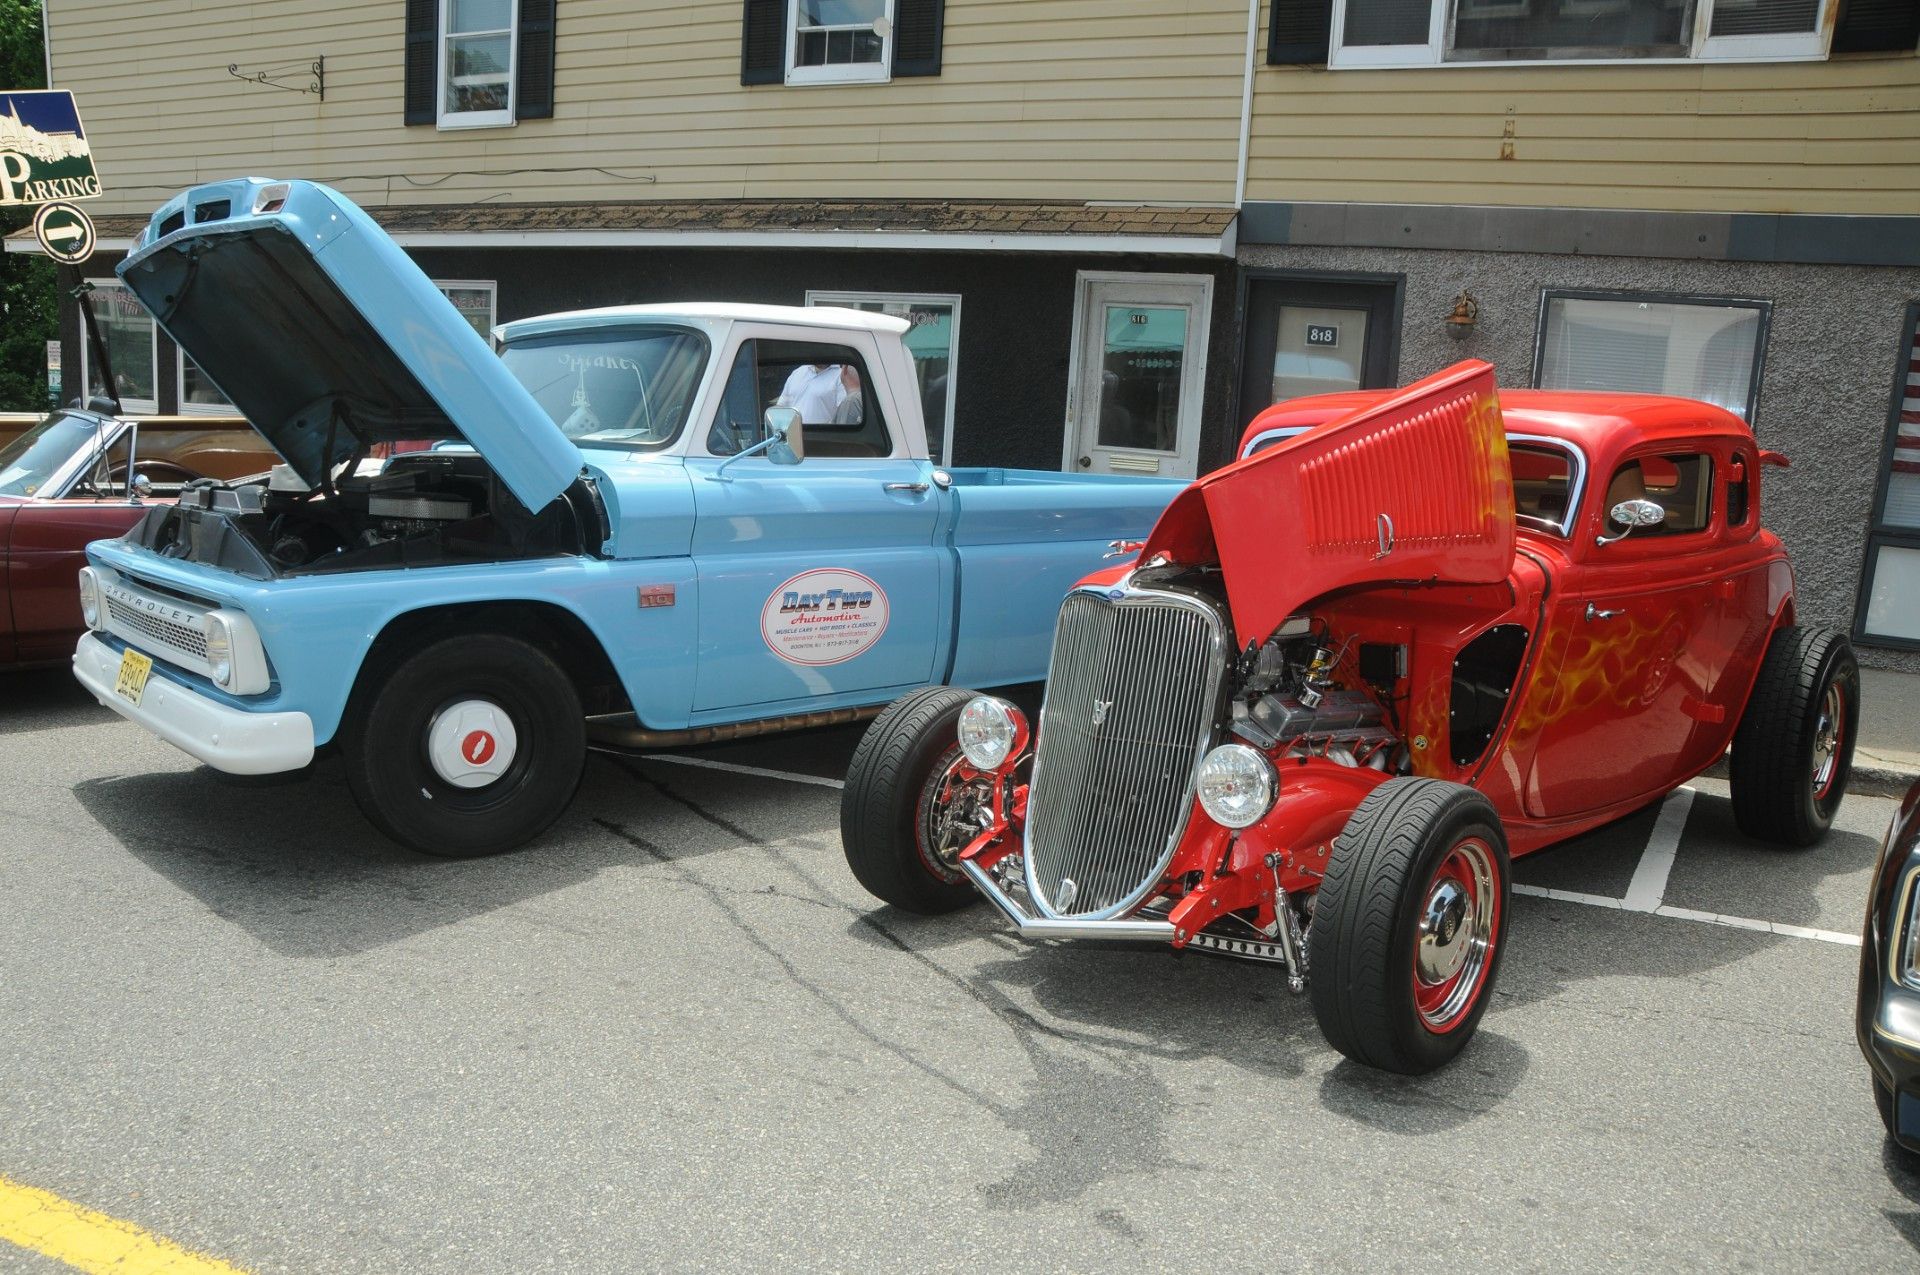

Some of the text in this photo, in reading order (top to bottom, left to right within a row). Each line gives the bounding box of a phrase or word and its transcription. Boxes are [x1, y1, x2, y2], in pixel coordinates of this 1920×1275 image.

[1310, 328, 1333, 342] 818
[105, 586, 195, 623] CHEVROLET
[791, 612, 862, 625] Automotive
[851, 621, 877, 629] CLASSICS
